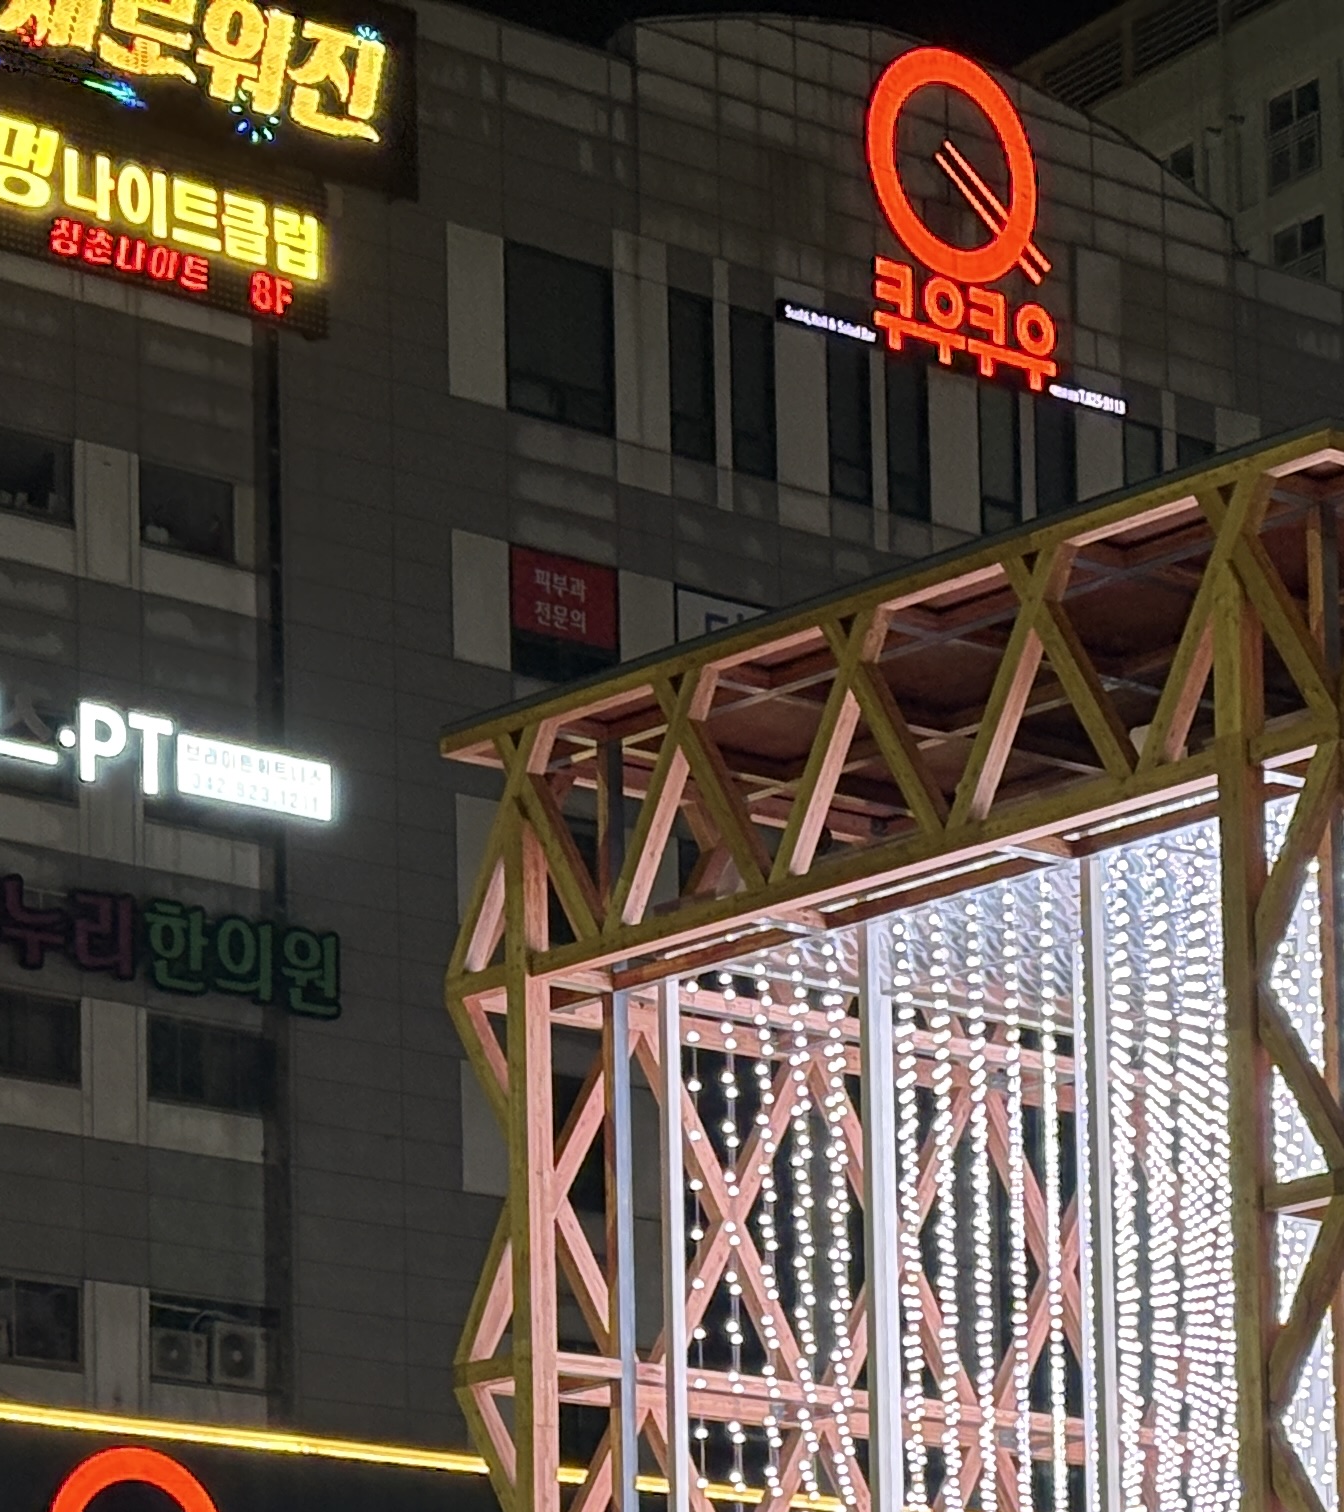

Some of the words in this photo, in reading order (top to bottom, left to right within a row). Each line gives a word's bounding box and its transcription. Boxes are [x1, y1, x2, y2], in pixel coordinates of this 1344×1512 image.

[873, 255, 1057, 392] 쿠우쿠우
[534, 567, 588, 603] 피부과
[535, 600, 588, 635] 전문의
